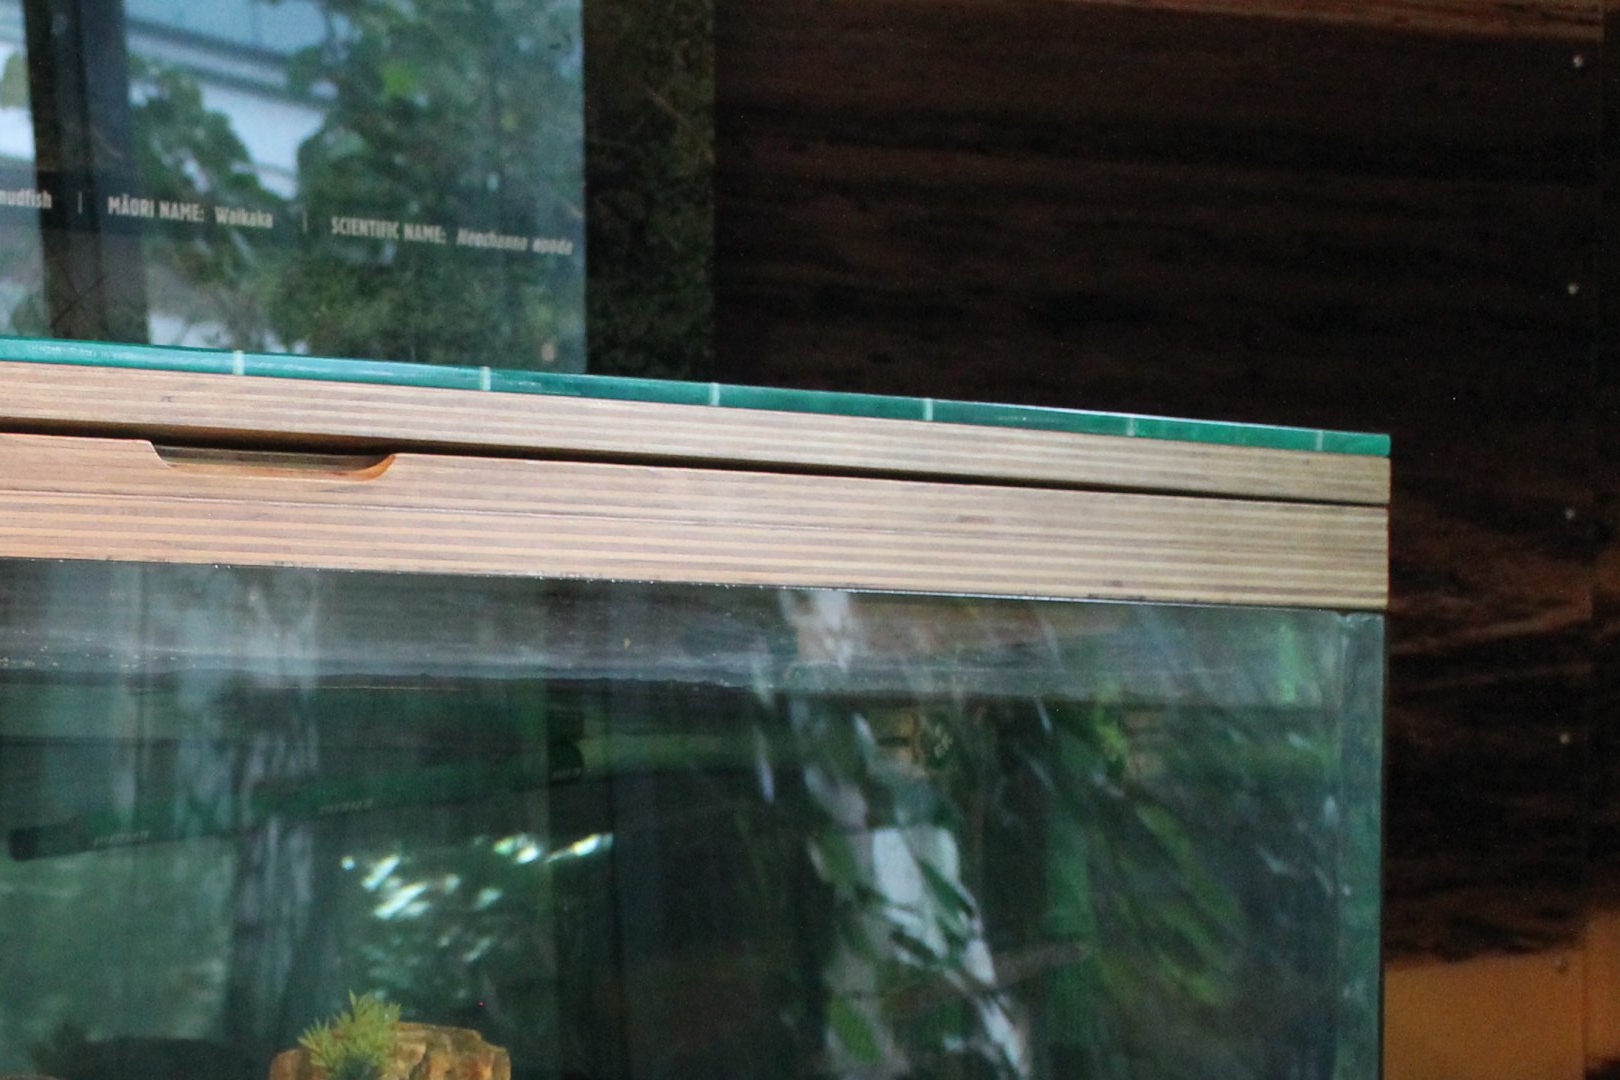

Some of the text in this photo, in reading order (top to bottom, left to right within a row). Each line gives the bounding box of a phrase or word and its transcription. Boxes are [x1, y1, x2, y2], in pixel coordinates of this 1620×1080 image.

[159, 201, 204, 222] NAME:
[331, 216, 446, 244] SCIENTIFIC NAME:
